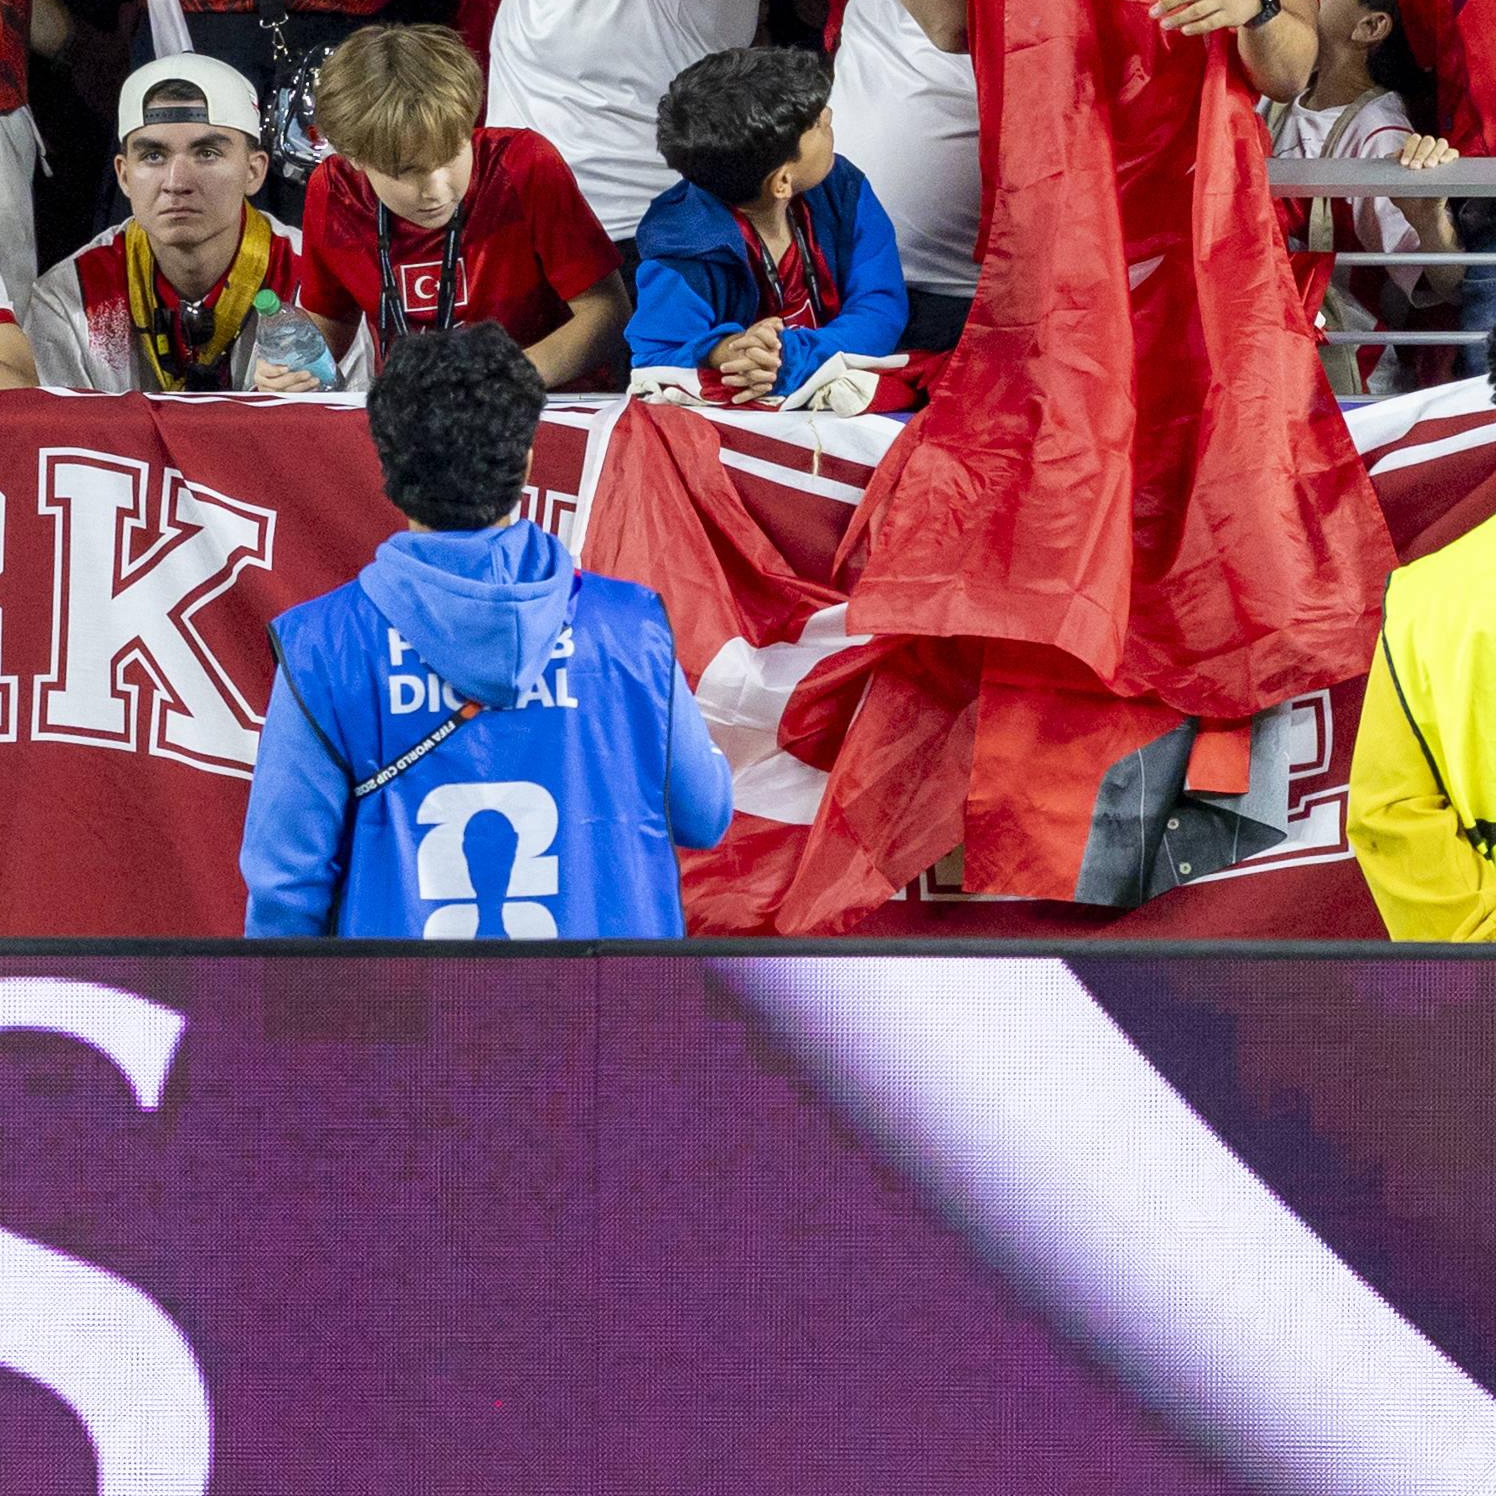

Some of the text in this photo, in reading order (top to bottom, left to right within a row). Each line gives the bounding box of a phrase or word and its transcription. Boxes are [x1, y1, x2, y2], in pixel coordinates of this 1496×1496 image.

[388, 668, 579, 715] DIAL
[353, 719, 456, 798] FIFA WORLD CUP 202
